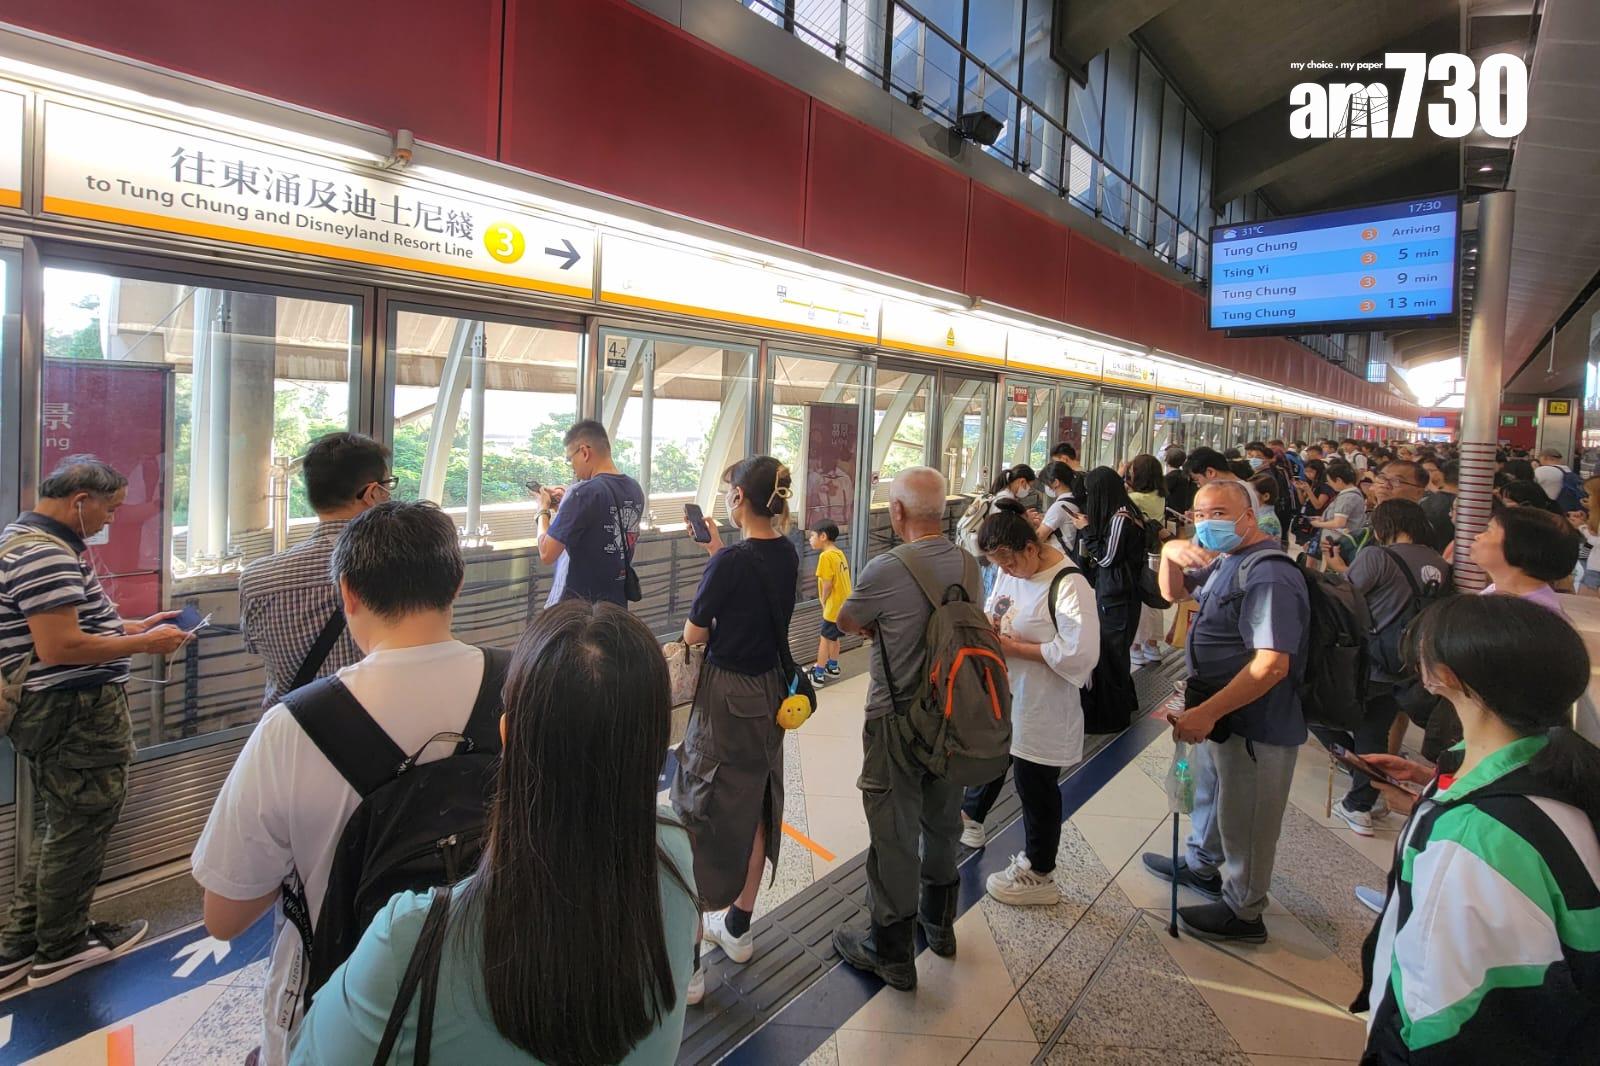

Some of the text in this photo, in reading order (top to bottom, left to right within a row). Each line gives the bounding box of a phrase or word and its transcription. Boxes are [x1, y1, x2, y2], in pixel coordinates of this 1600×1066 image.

[170, 146, 474, 241] 往東涌及迪士尼綫
[1408, 200, 1441, 213] 17:30
[86, 175, 473, 259] to Tung Chung and Disneyland Resort Line
[495, 227, 514, 257] 3
[1224, 223, 1440, 257] Tung Chung 3 Arriving
[1223, 248, 1439, 278] Tsing Yi 3 5 min
[1222, 272, 1438, 300] Tung Chung 3 9 min
[1222, 297, 1437, 321] Tung Chung 3 13 min
